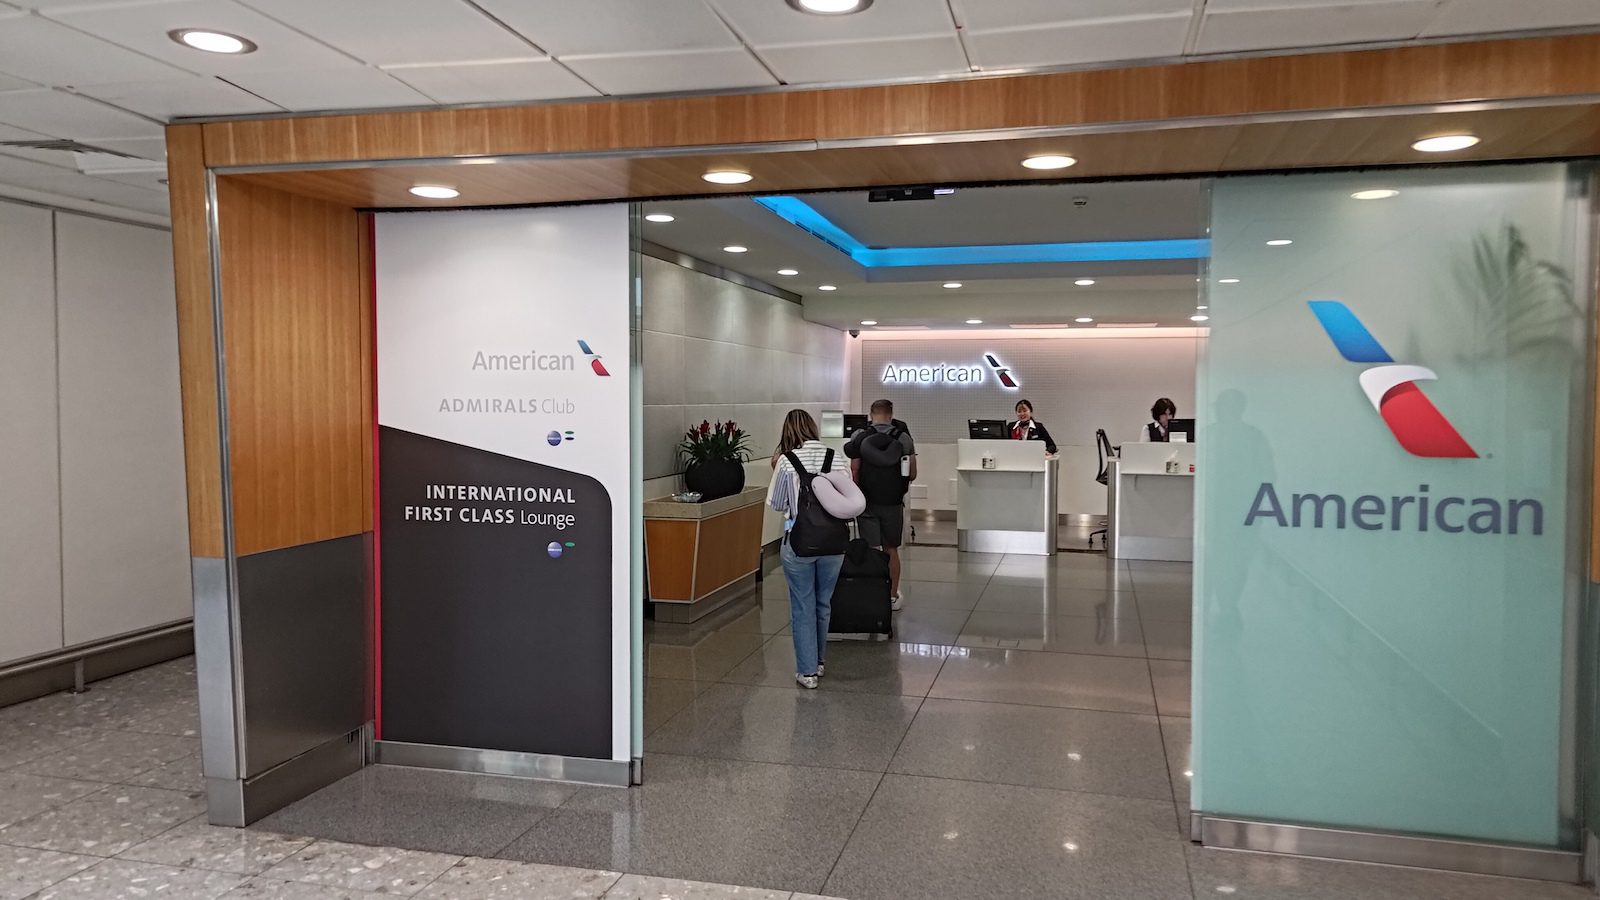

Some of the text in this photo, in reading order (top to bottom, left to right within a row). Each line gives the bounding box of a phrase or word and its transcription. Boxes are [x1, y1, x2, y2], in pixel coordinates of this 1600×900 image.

[472, 350, 575, 371] American
[882, 363, 983, 384] American
[439, 398, 575, 415] ADMIRALS Club
[426, 484, 576, 504] INTERNATIONAL
[405, 506, 576, 530] FIRST CLASS Lounge
[1244, 482, 1544, 536] American
